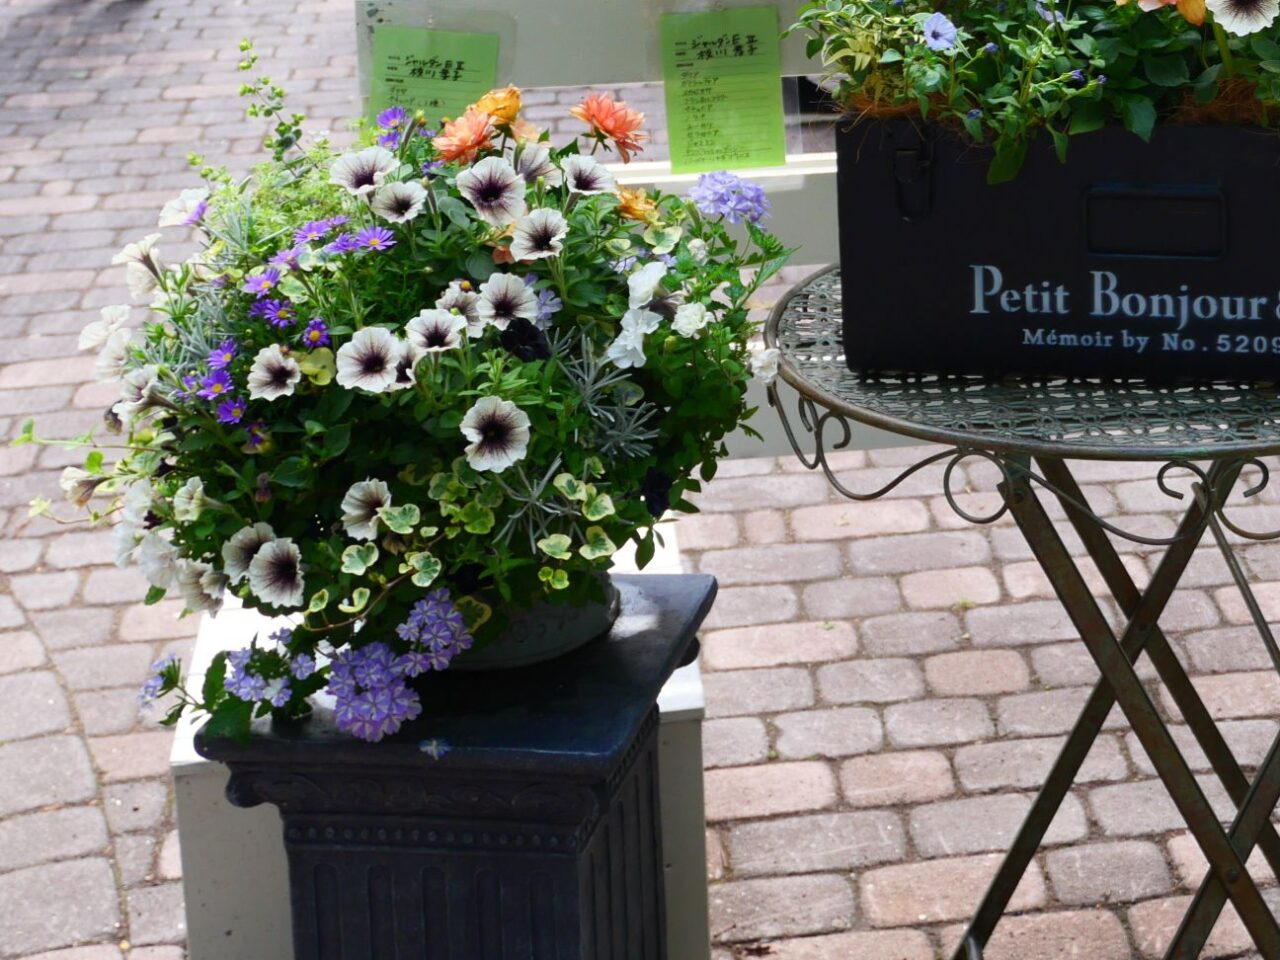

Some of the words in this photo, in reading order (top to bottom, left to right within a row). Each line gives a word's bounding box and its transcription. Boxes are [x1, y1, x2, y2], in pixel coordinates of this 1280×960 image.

[969, 264, 1071, 314] Petit
[1089, 270, 1268, 330] Bonjour
[1022, 327, 1113, 347] Mémoir
[1122, 329, 1149, 353] by
